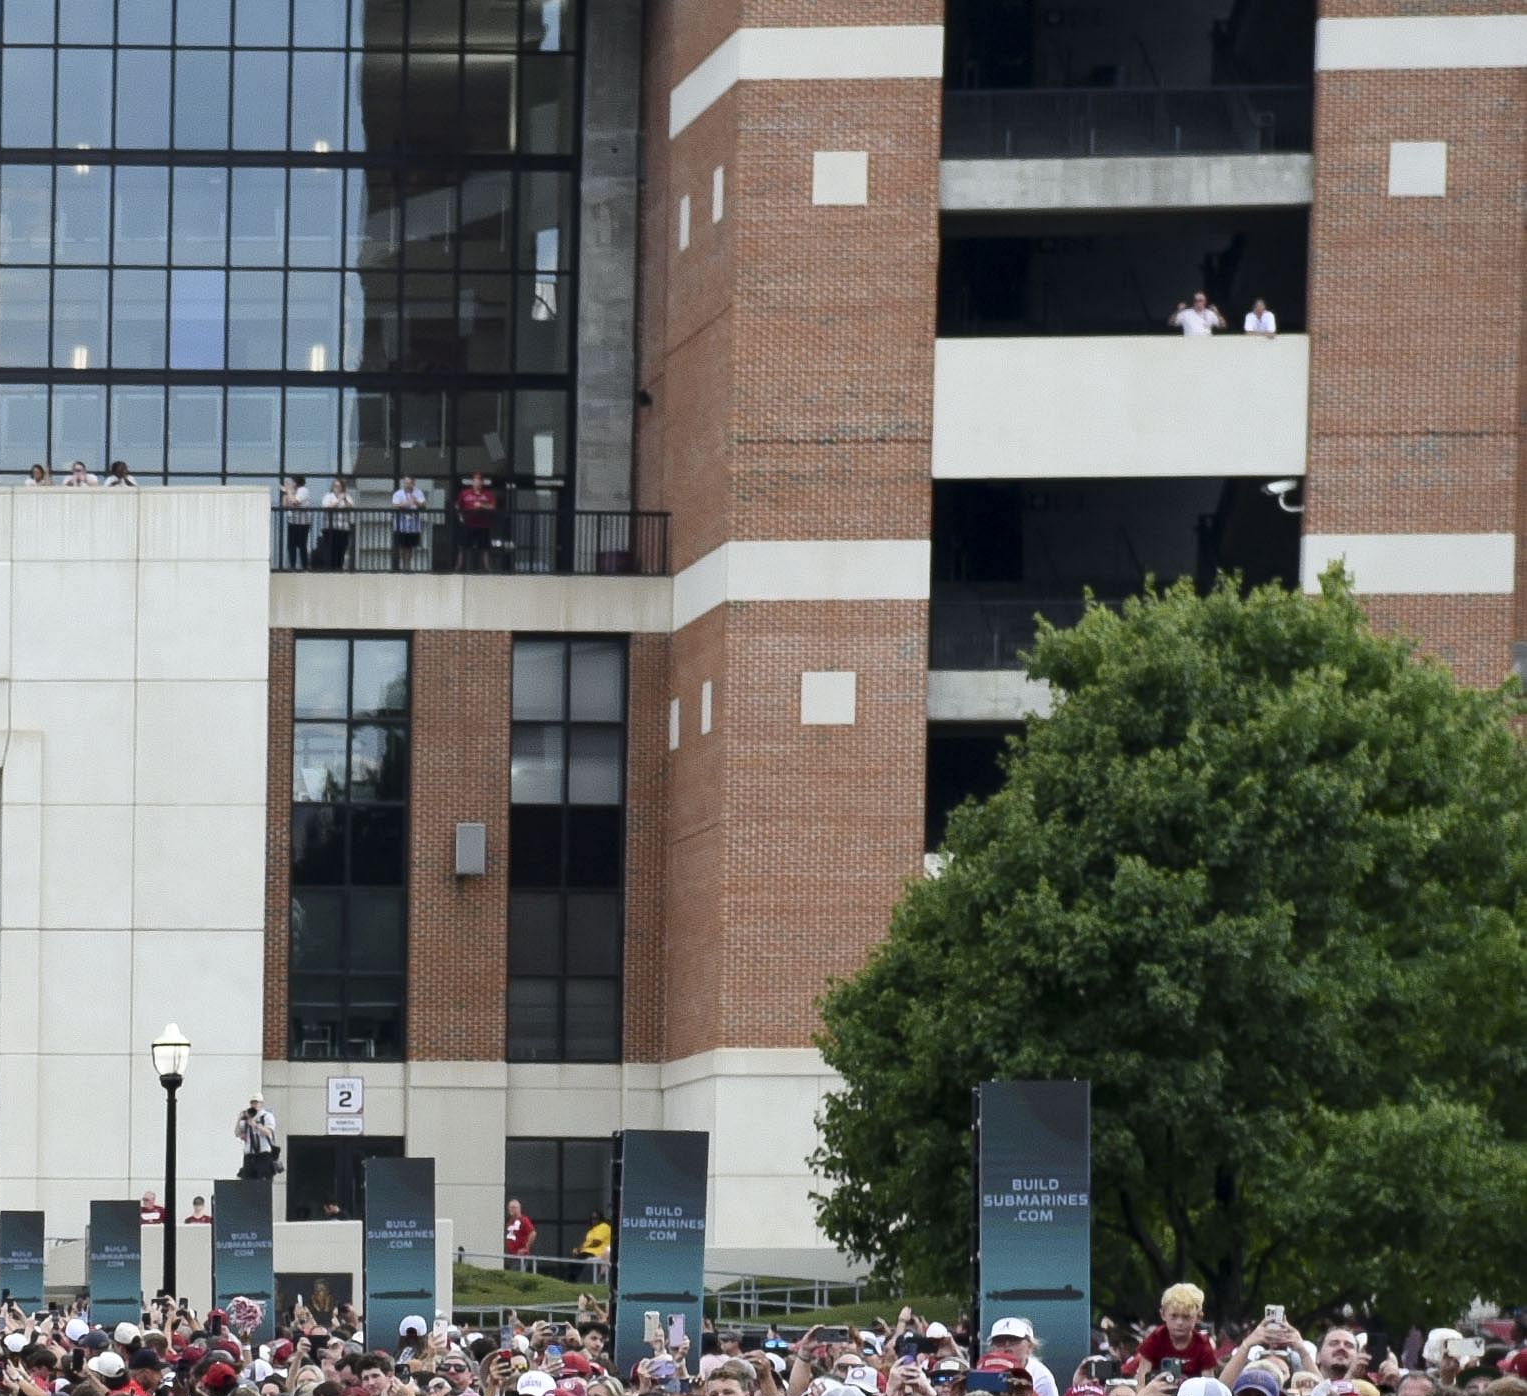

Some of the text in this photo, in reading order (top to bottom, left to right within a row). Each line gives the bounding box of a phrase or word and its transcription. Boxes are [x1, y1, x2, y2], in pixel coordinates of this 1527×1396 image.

[338, 1091, 352, 1108] 2
[1011, 1178, 1059, 1191] BUILD
[983, 1193, 1089, 1207] SUBMARINES
[645, 1206, 683, 1217] BUILD
[385, 1220, 417, 1229] BUILD
[622, 1217, 705, 1230] SUBMARINES
[367, 1230, 435, 1239] SUBMARINES
